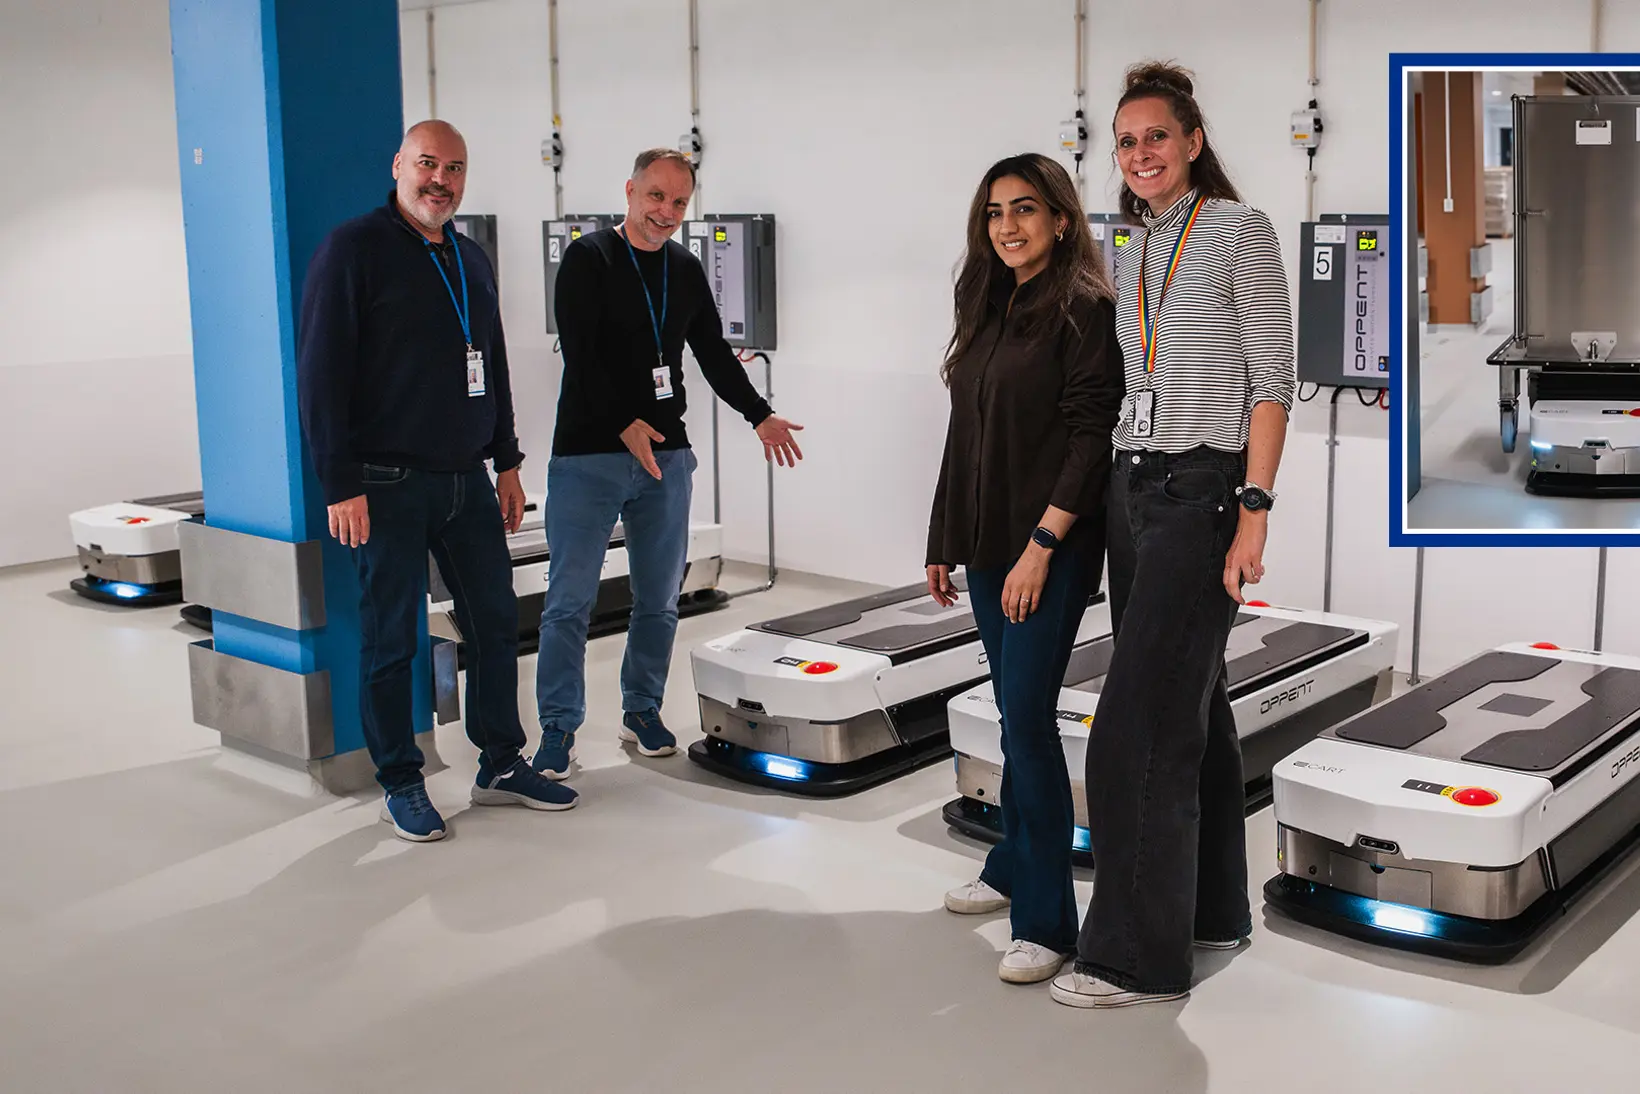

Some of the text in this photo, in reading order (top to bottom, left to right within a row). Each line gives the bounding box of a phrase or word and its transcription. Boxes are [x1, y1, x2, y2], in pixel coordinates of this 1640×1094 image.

[551, 241, 559, 259] 2
[692, 243, 700, 259] 3
[1316, 251, 1330, 275] 5
[715, 252, 723, 320] PPENT
[1355, 264, 1368, 371] OPPENT
[1260, 679, 1315, 714] OPPENT
[1611, 745, 1640, 778] OPPE
